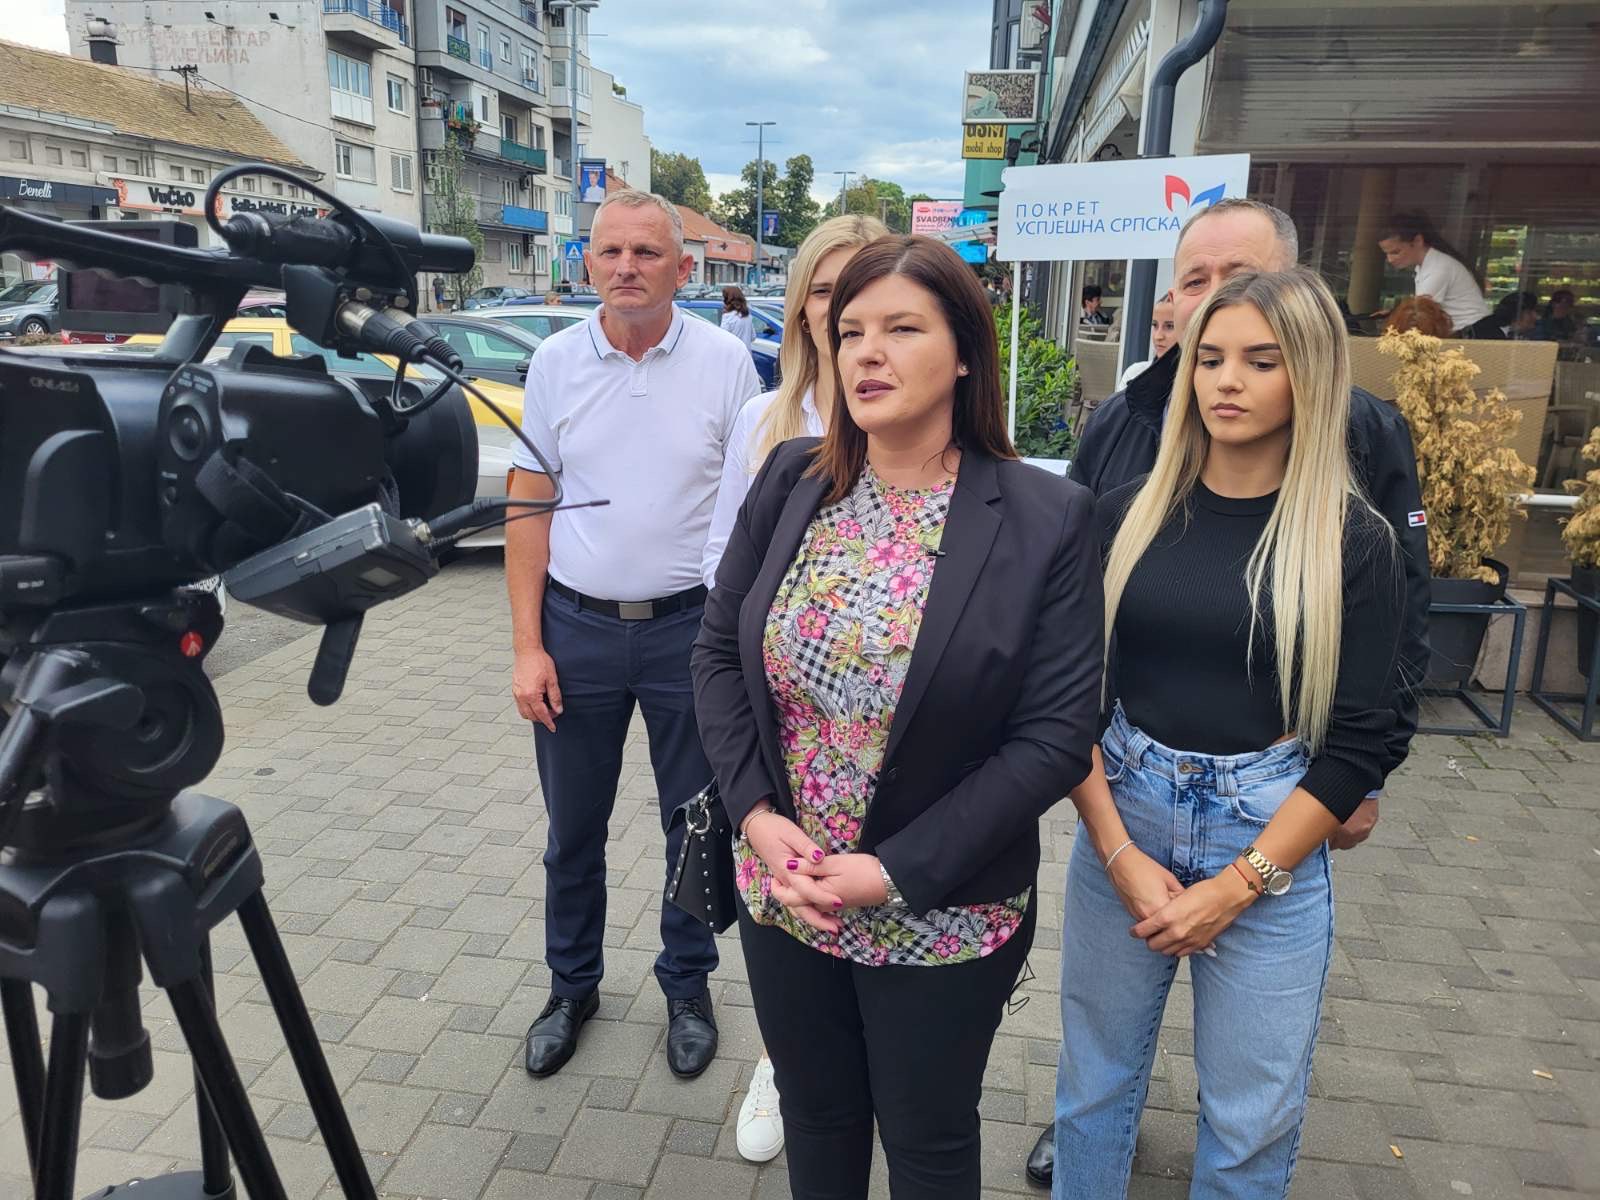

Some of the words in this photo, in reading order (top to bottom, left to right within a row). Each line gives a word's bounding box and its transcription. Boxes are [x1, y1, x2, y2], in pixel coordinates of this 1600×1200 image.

[965, 142, 984, 153] mobil
[986, 142, 1003, 156] shop
[19, 179, 53, 199] Benelli
[1015, 201, 1100, 218] ПОКРЕТ
[1015, 219, 1106, 236] УСПЈЕШНА
[1109, 216, 1182, 233] СРПСКА
